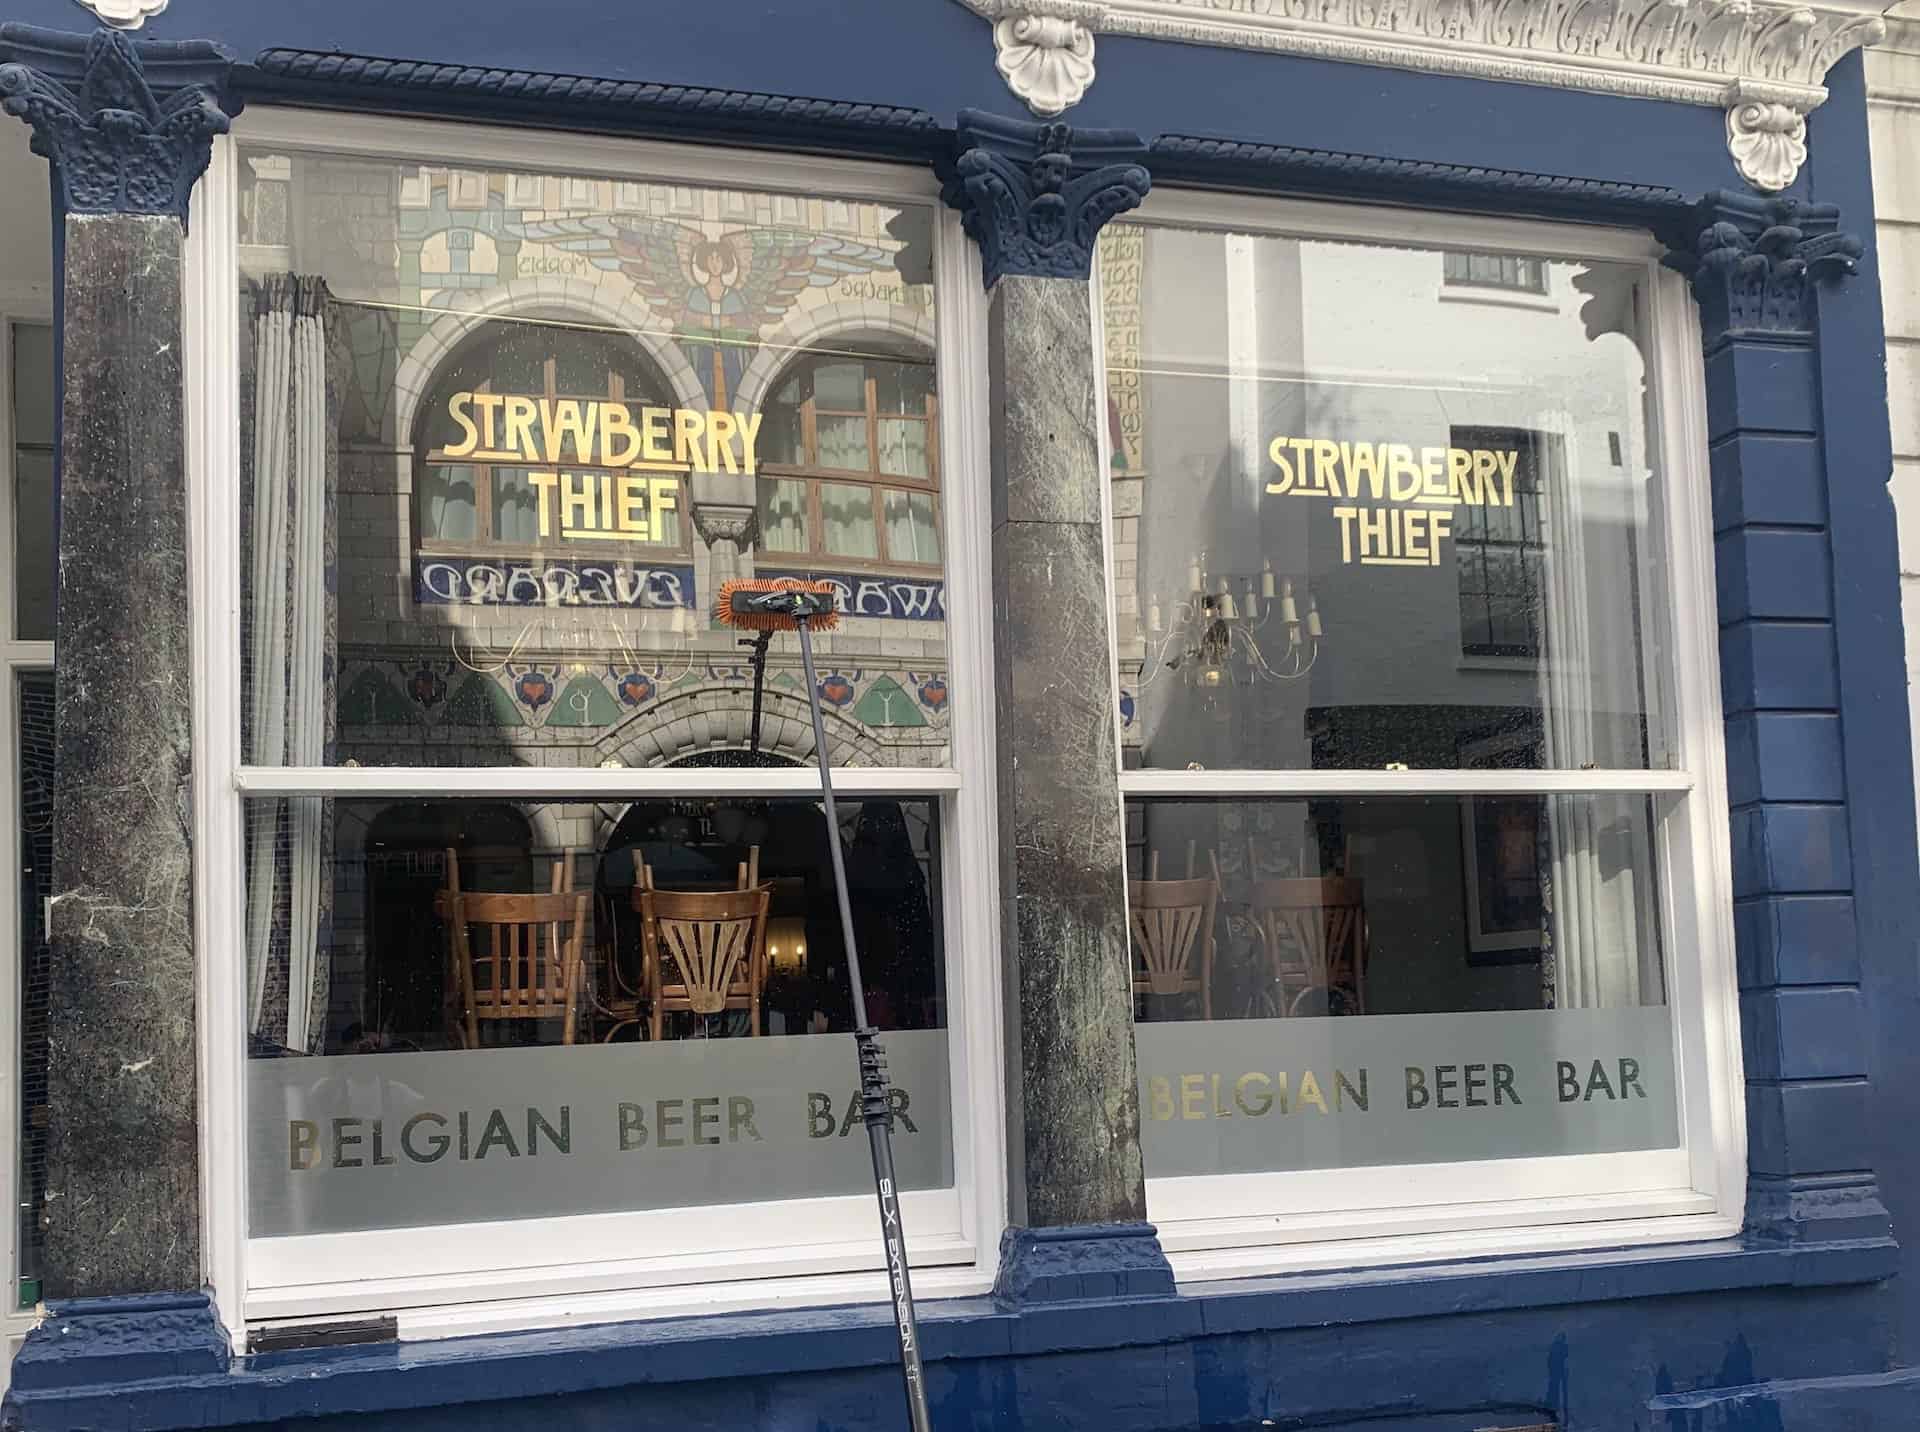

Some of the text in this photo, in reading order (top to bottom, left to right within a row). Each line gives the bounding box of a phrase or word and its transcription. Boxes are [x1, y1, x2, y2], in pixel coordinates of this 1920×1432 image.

[528, 471, 679, 541] THIEF
[1333, 506, 1453, 567] THIEF
[1147, 1057, 1648, 1121] BELGIAN BEER BAR
[289, 1088, 919, 1170] BELGIAN BEER BAR
[879, 1177, 914, 1352] SLX EXTENSION
